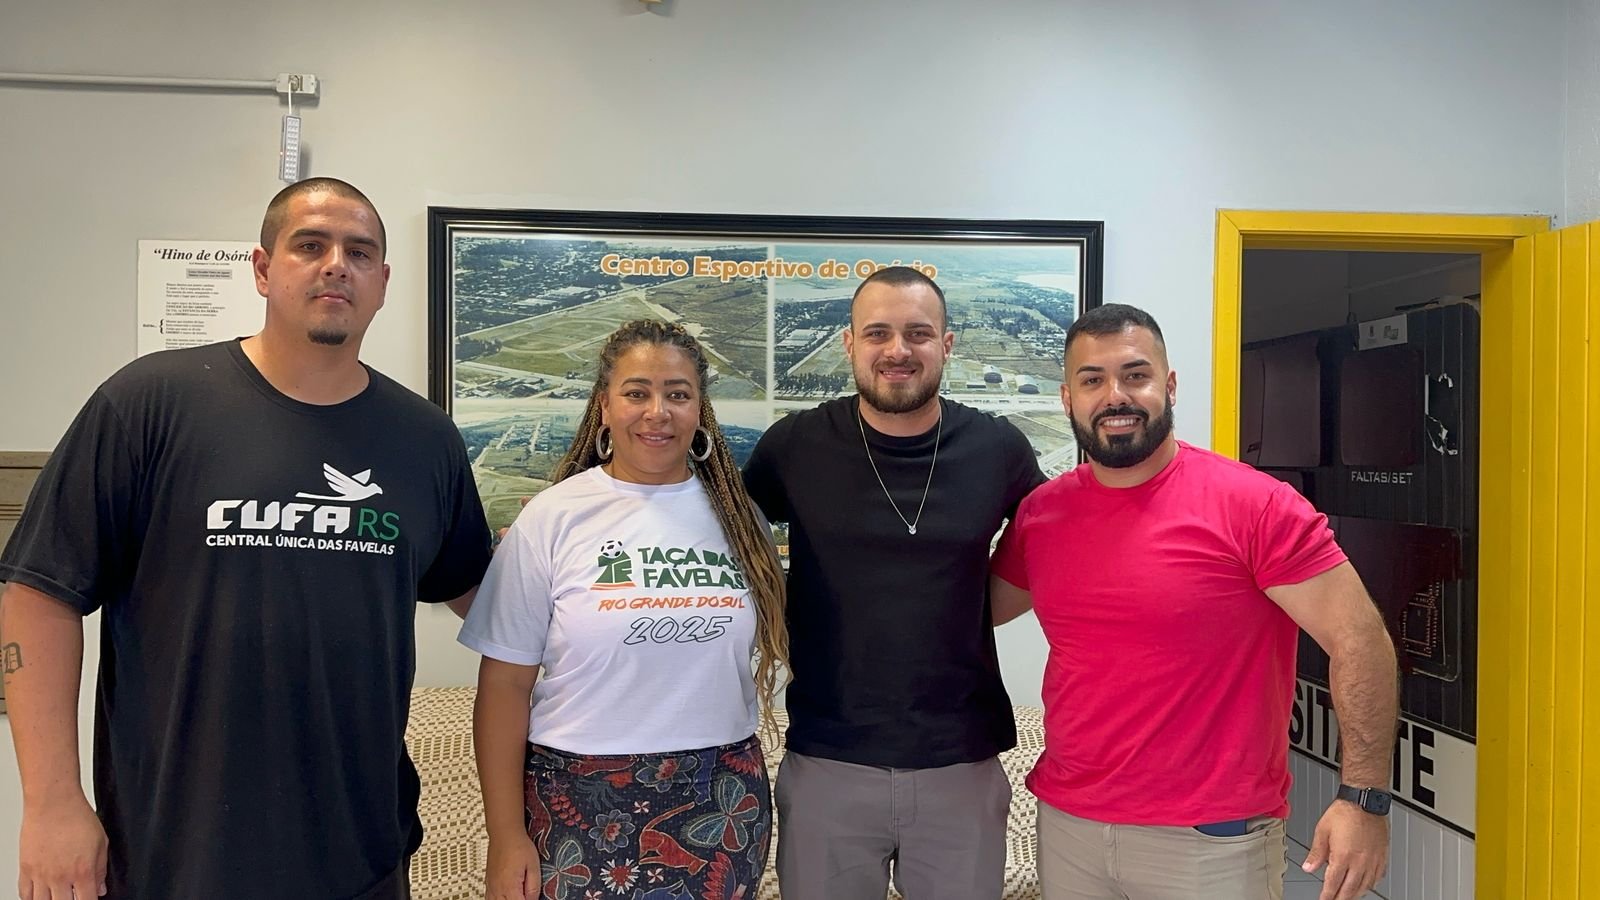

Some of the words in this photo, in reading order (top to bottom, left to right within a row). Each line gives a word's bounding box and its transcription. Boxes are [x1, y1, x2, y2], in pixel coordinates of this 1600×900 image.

[196, 250, 211, 261] de
[601, 253, 689, 277] Centro
[693, 255, 814, 283] Esportivo
[818, 258, 849, 280] de
[1351, 471, 1413, 484] FALTAS/SET
[207, 500, 351, 534] CUFA
[357, 507, 400, 541] RS
[205, 534, 272, 547] CENTRAL
[275, 534, 315, 550] ÚNICA
[317, 539, 343, 551] DAS
[345, 540, 395, 556] FAVELAS
[637, 546, 702, 568] TAÇA
[642, 567, 748, 590] FAVELAS
[598, 598, 627, 612] RIO
[629, 596, 693, 609] GRANDE
[623, 615, 733, 645] 2025
